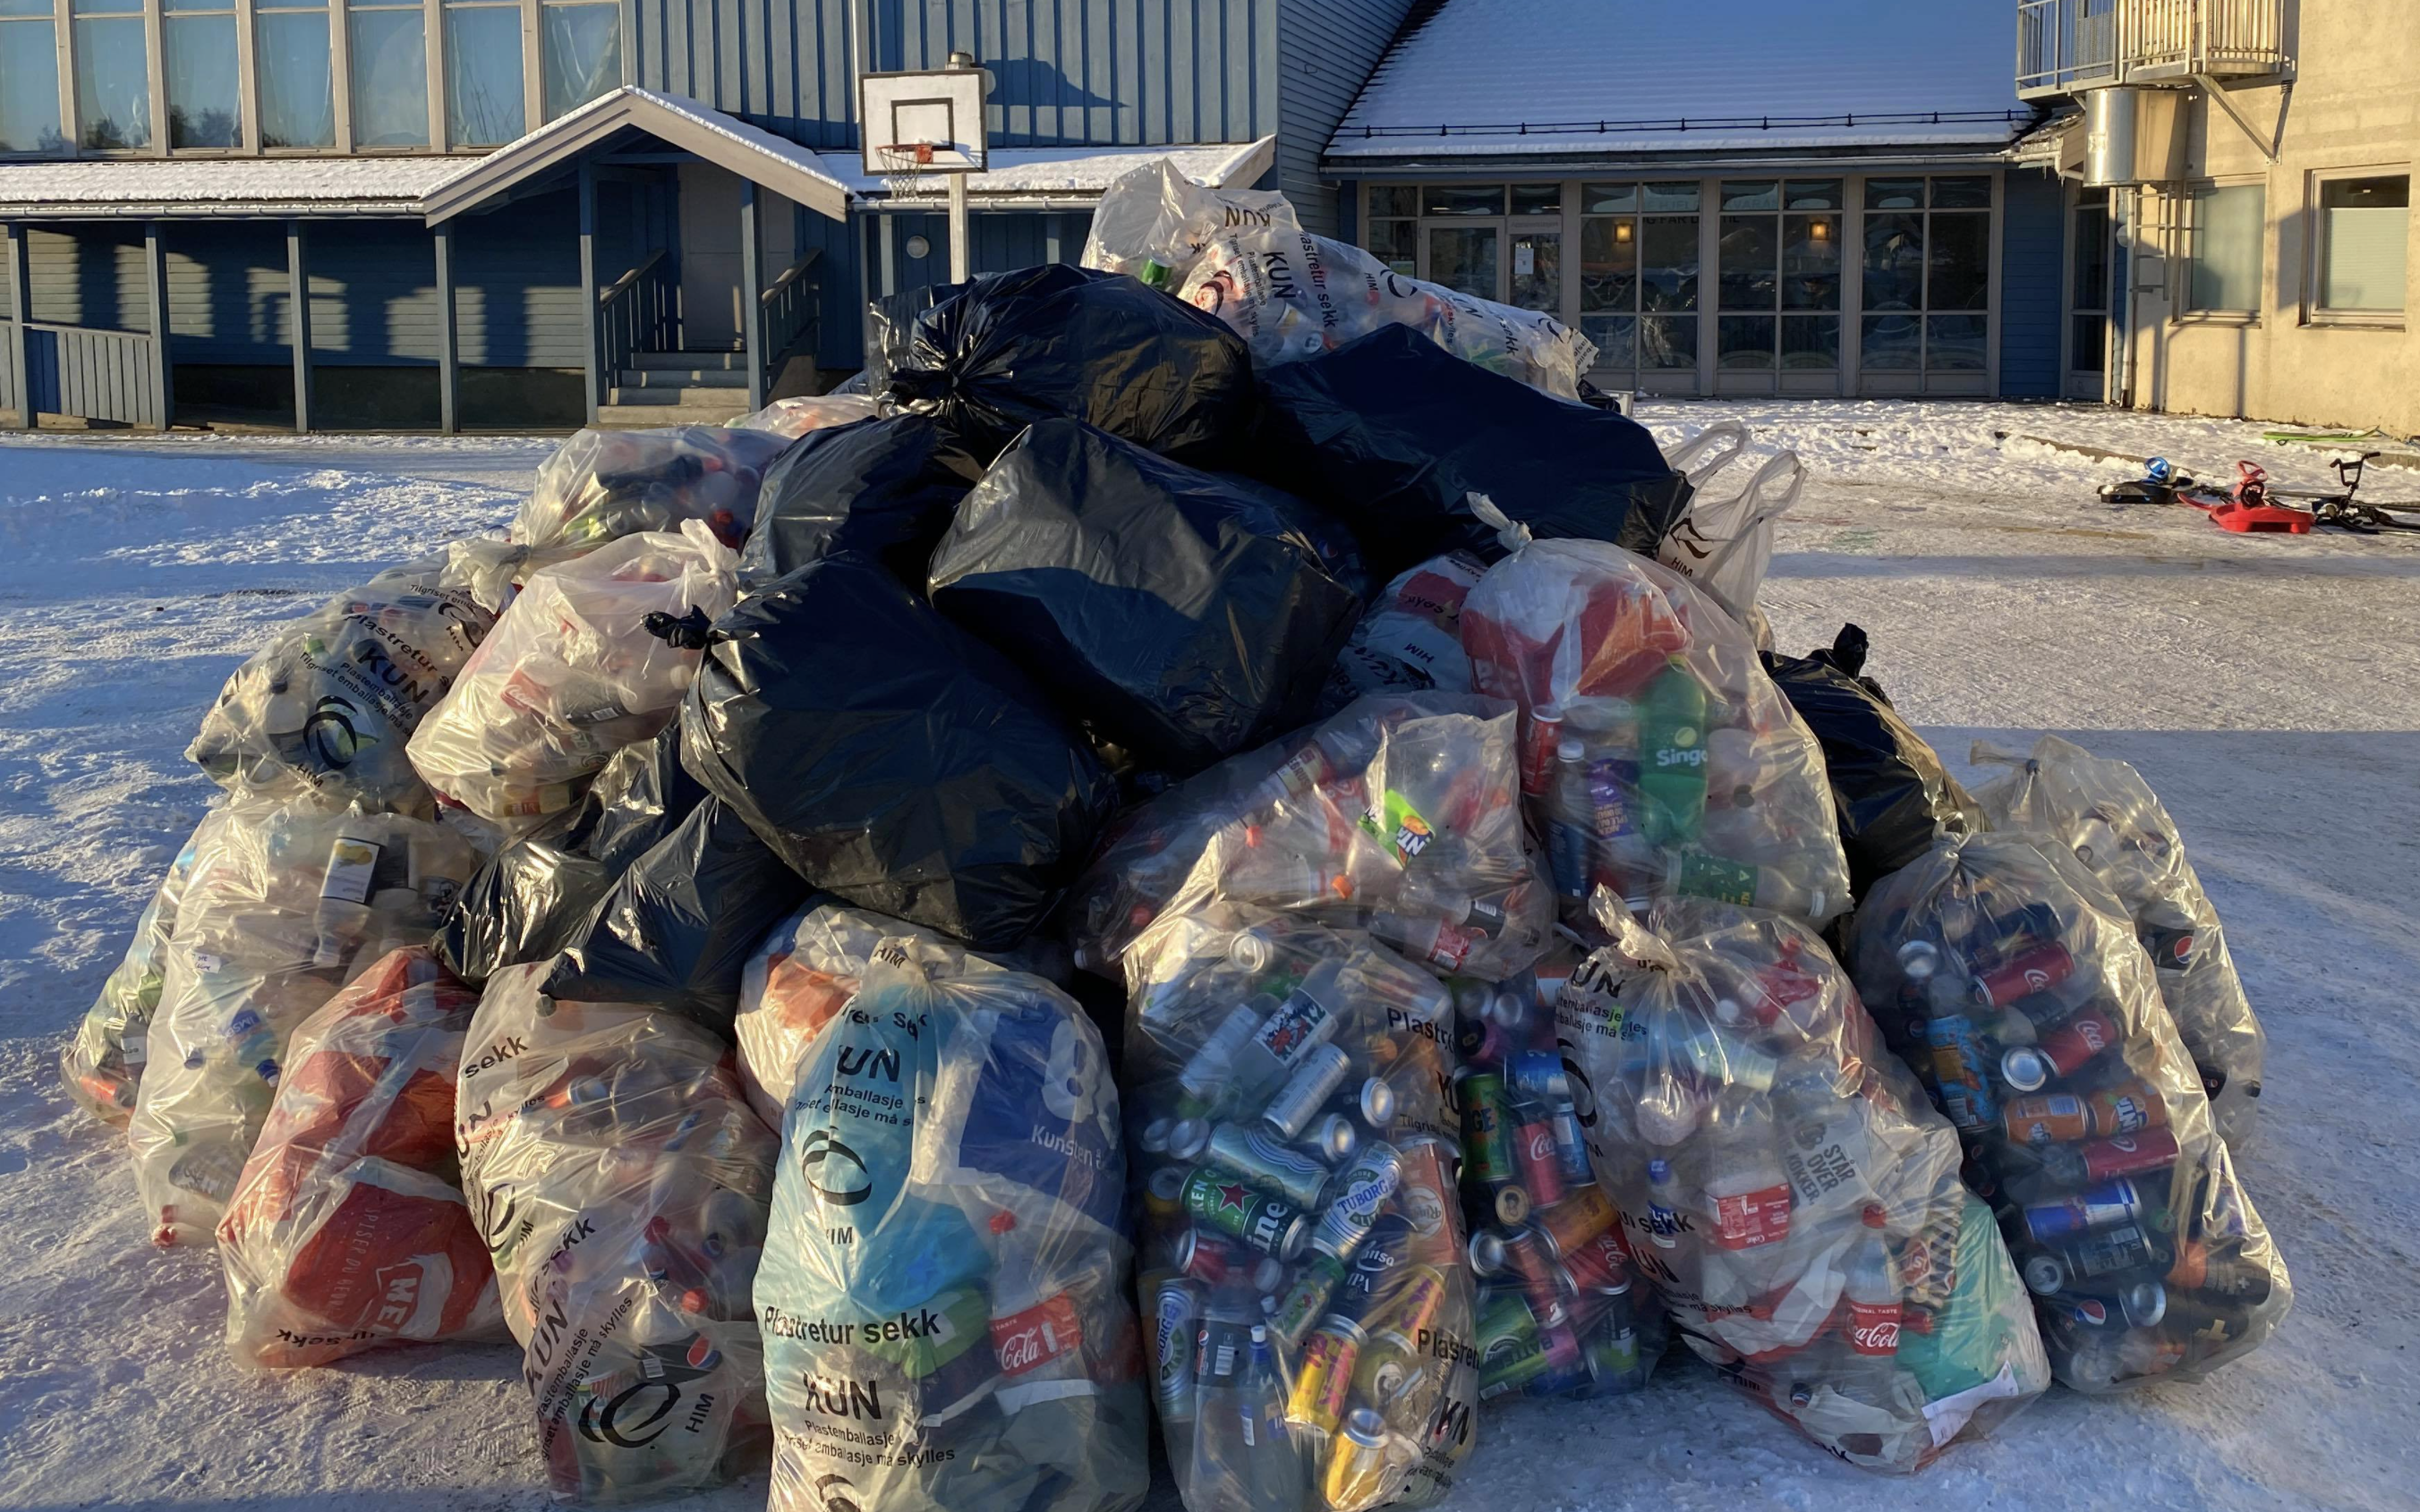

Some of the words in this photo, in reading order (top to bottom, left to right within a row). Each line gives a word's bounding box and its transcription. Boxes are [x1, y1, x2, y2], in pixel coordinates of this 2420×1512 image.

[1263, 251, 1297, 299] KUN
[1299, 231, 1326, 290] lastretur
[1317, 293, 1339, 328] sekk
[1364, 272, 1379, 292] HIM
[1671, 556, 1693, 577] HIM
[344, 615, 438, 674] Plastretur
[446, 625, 464, 652] HIM
[1404, 642, 1435, 664] HIM
[357, 648, 430, 703] KUN
[296, 762, 325, 788] HIM
[1571, 961, 1626, 998] UN
[464, 1036, 529, 1079] sekk
[837, 1045, 900, 1083] UN
[1031, 1124, 1093, 1167] Kunsten
[1823, 1143, 1856, 1182] STÅR
[1807, 1153, 1839, 1193] OVER
[1337, 1180, 1388, 1214] TUBORG
[1639, 1212, 1696, 1235] sekk
[600, 1297, 633, 1338] skylles
[764, 1305, 855, 1346] Plastretur
[863, 1308, 941, 1343] sekk
[685, 1392, 715, 1434] HIM
[803, 1372, 882, 1421] KUN
[805, 1420, 894, 1447] Plastemballasje
[898, 1449, 955, 1468] skylles
